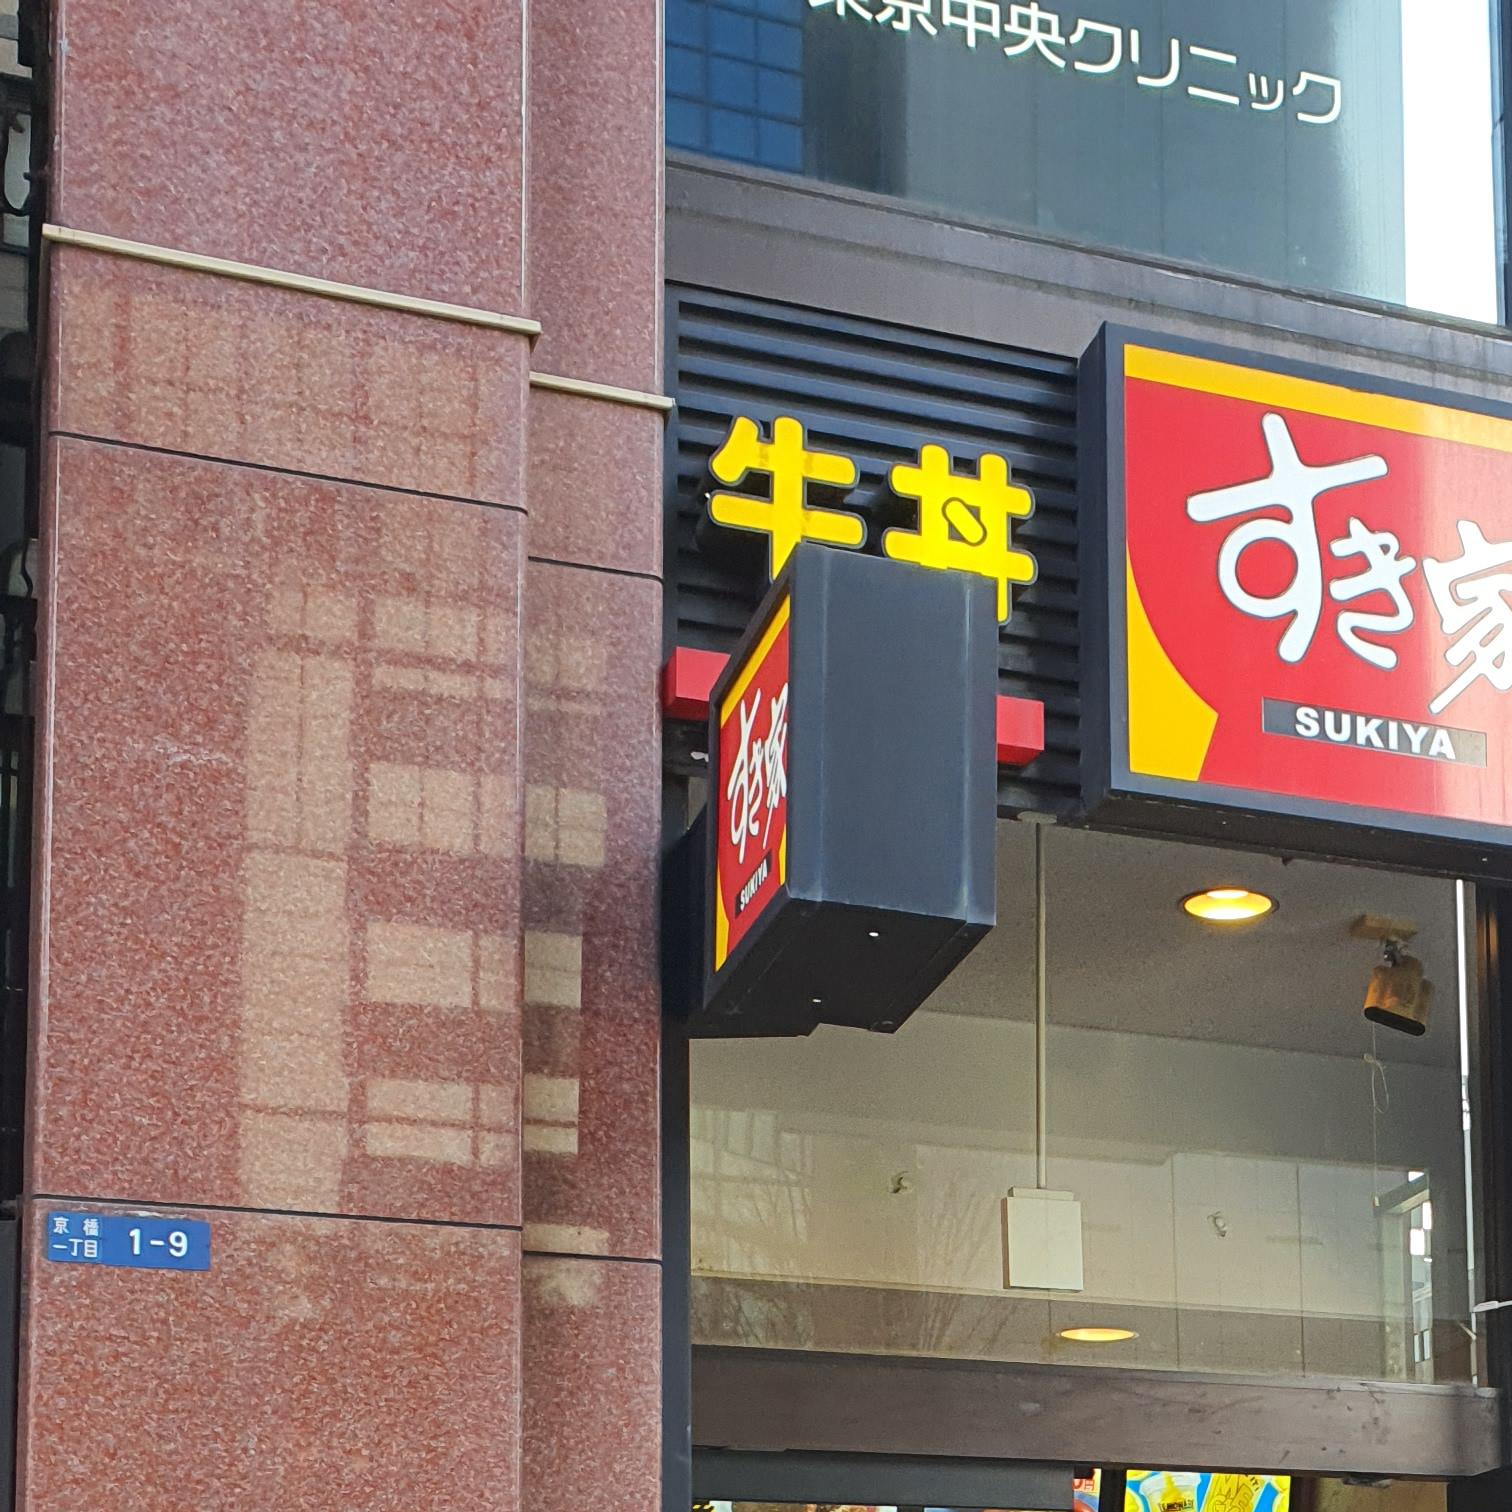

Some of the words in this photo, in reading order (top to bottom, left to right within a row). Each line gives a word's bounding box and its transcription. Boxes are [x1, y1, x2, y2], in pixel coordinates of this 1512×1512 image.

[708, 415, 1039, 626] 牛丼
[1294, 706, 1458, 761] SUKIYA
[727, 682, 789, 864] すき家
[739, 858, 769, 912] SUKIYA
[52, 1238, 98, 1258] 一丁目
[53, 1217, 99, 1237] 京橋
[128, 1228, 189, 1257] 1-9
